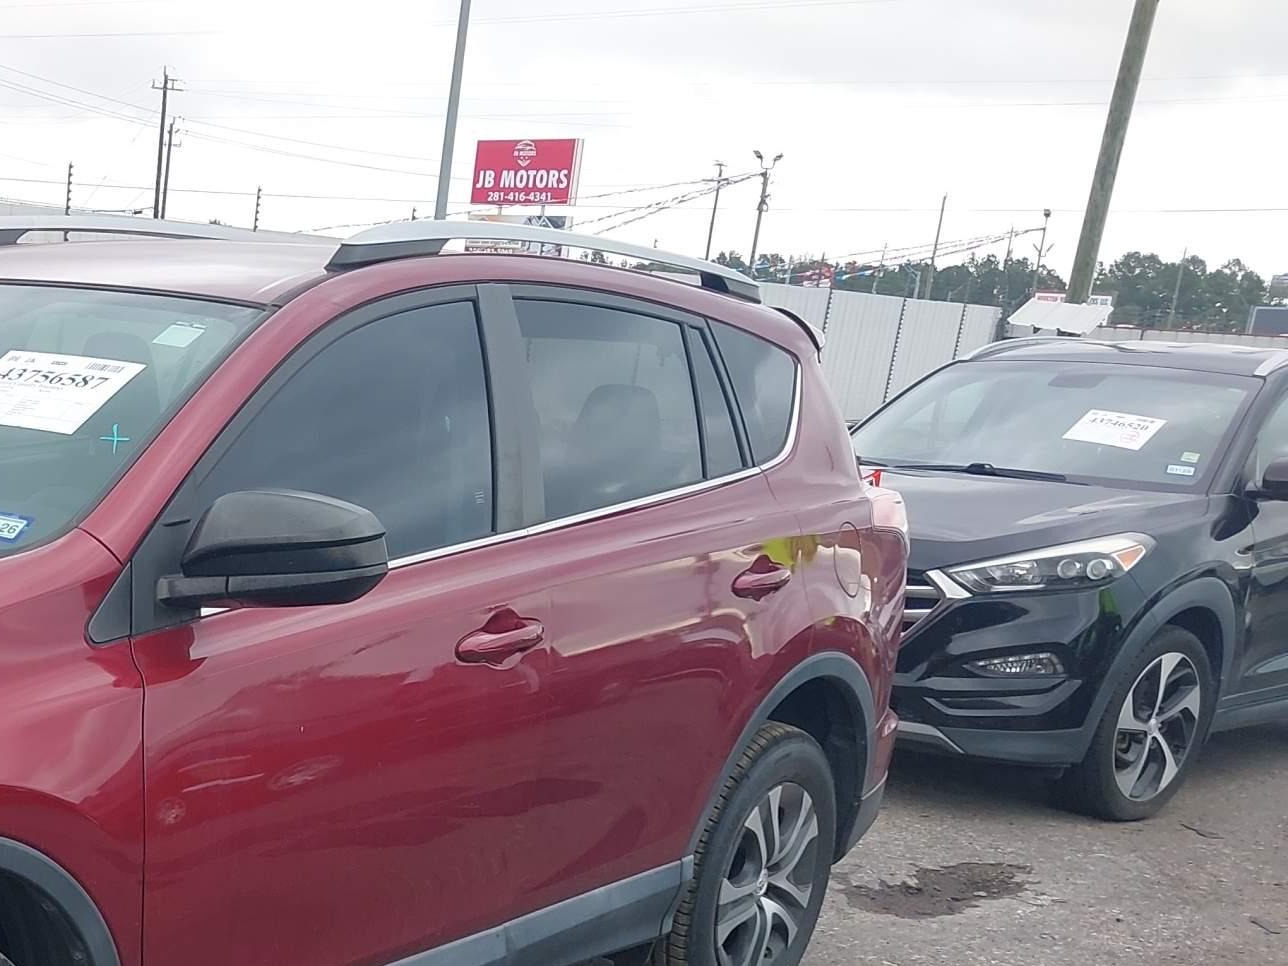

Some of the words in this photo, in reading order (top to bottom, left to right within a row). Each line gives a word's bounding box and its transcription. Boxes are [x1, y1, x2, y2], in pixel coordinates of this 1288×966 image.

[476, 170, 495, 188] JB
[500, 170, 568, 188] MOTORS
[487, 191, 551, 202] 281-416-4341
